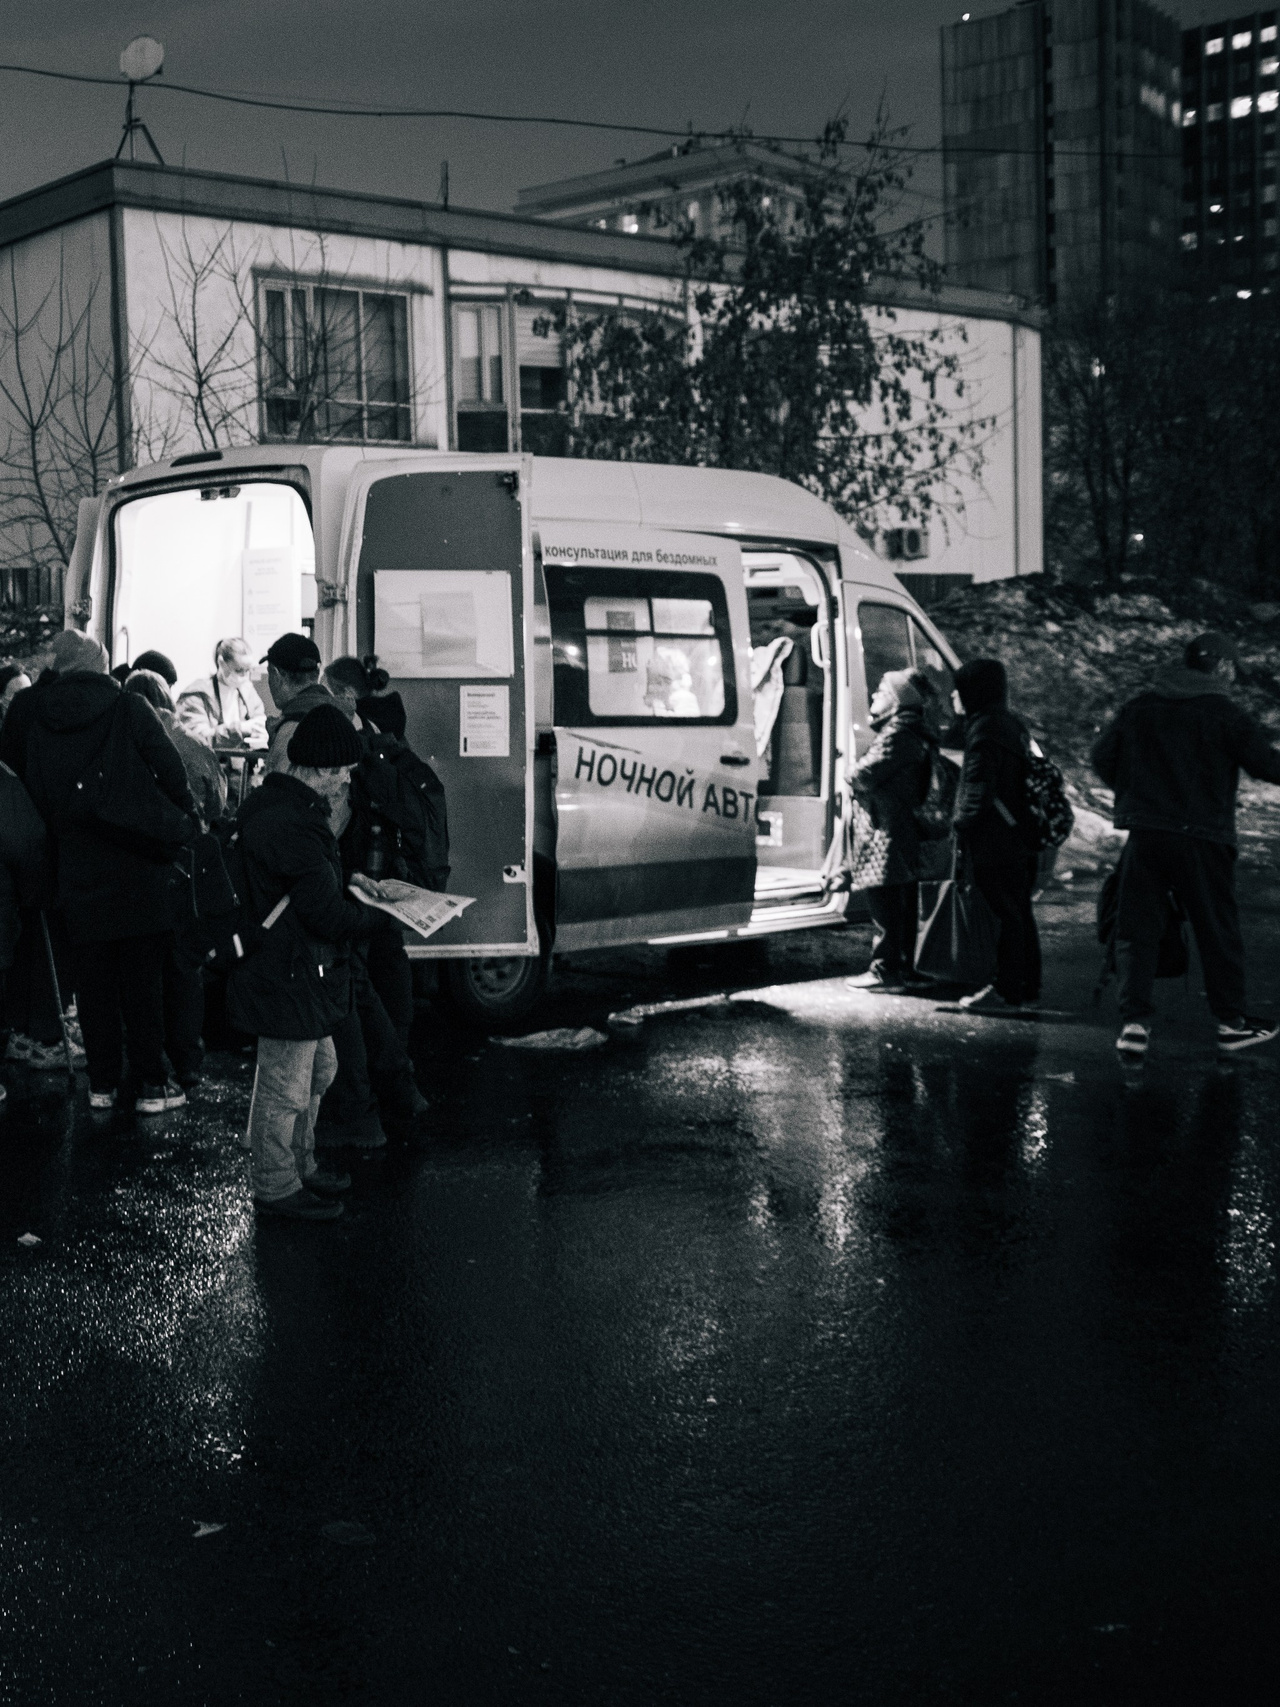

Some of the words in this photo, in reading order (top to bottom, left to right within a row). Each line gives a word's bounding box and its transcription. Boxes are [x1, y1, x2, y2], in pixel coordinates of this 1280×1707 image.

[544, 544, 628, 562] консультация
[631, 549, 653, 564] для
[656, 548, 718, 566] бездомных
[574, 745, 696, 810] НОЧНОЙ
